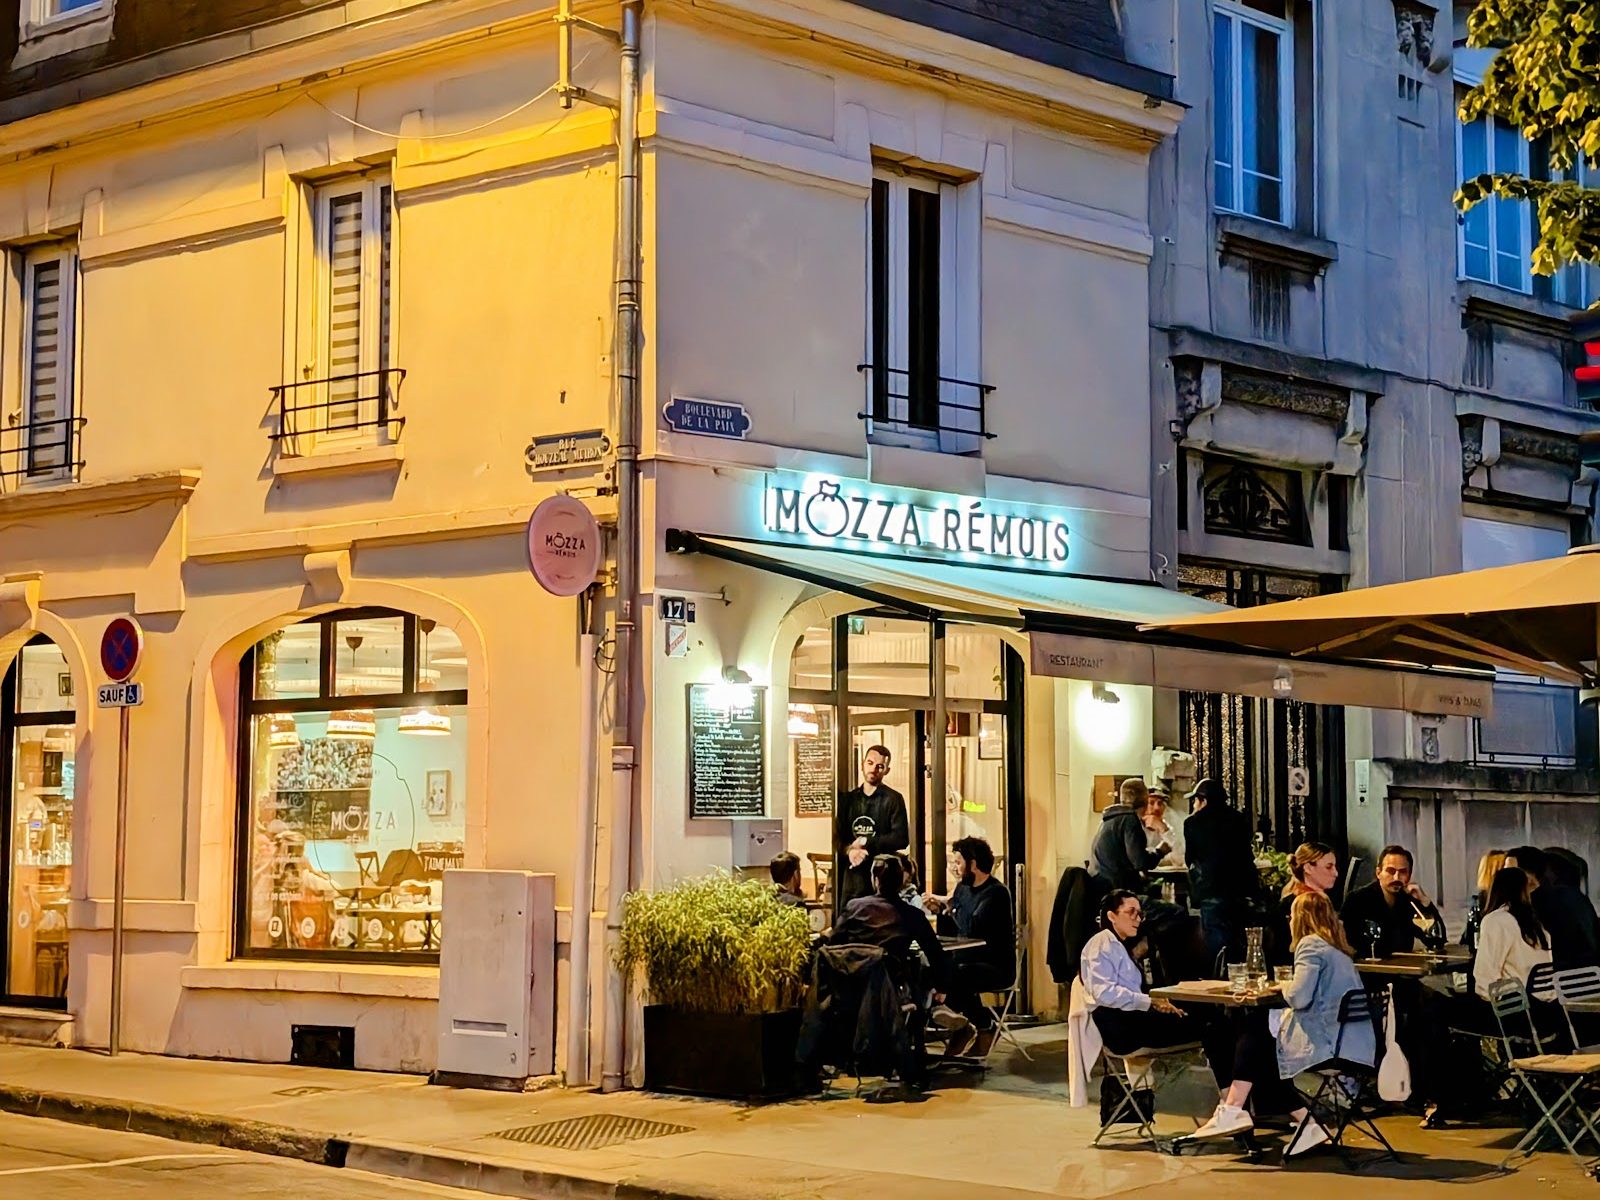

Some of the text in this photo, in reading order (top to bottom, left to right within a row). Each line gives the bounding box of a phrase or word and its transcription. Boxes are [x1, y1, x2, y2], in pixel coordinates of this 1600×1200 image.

[685, 403, 732, 419] BOULEVARD
[681, 414, 735, 433] DE LA PAIX
[559, 437, 577, 450] RUE
[776, 480, 1069, 561] MOZZA RÉMOIS
[546, 532, 585, 550] MOZZA
[667, 600, 683, 618] 17
[1049, 654, 1104, 669] RESTAURANT
[99, 688, 125, 703] SAUF
[330, 805, 397, 832] MOZZA
